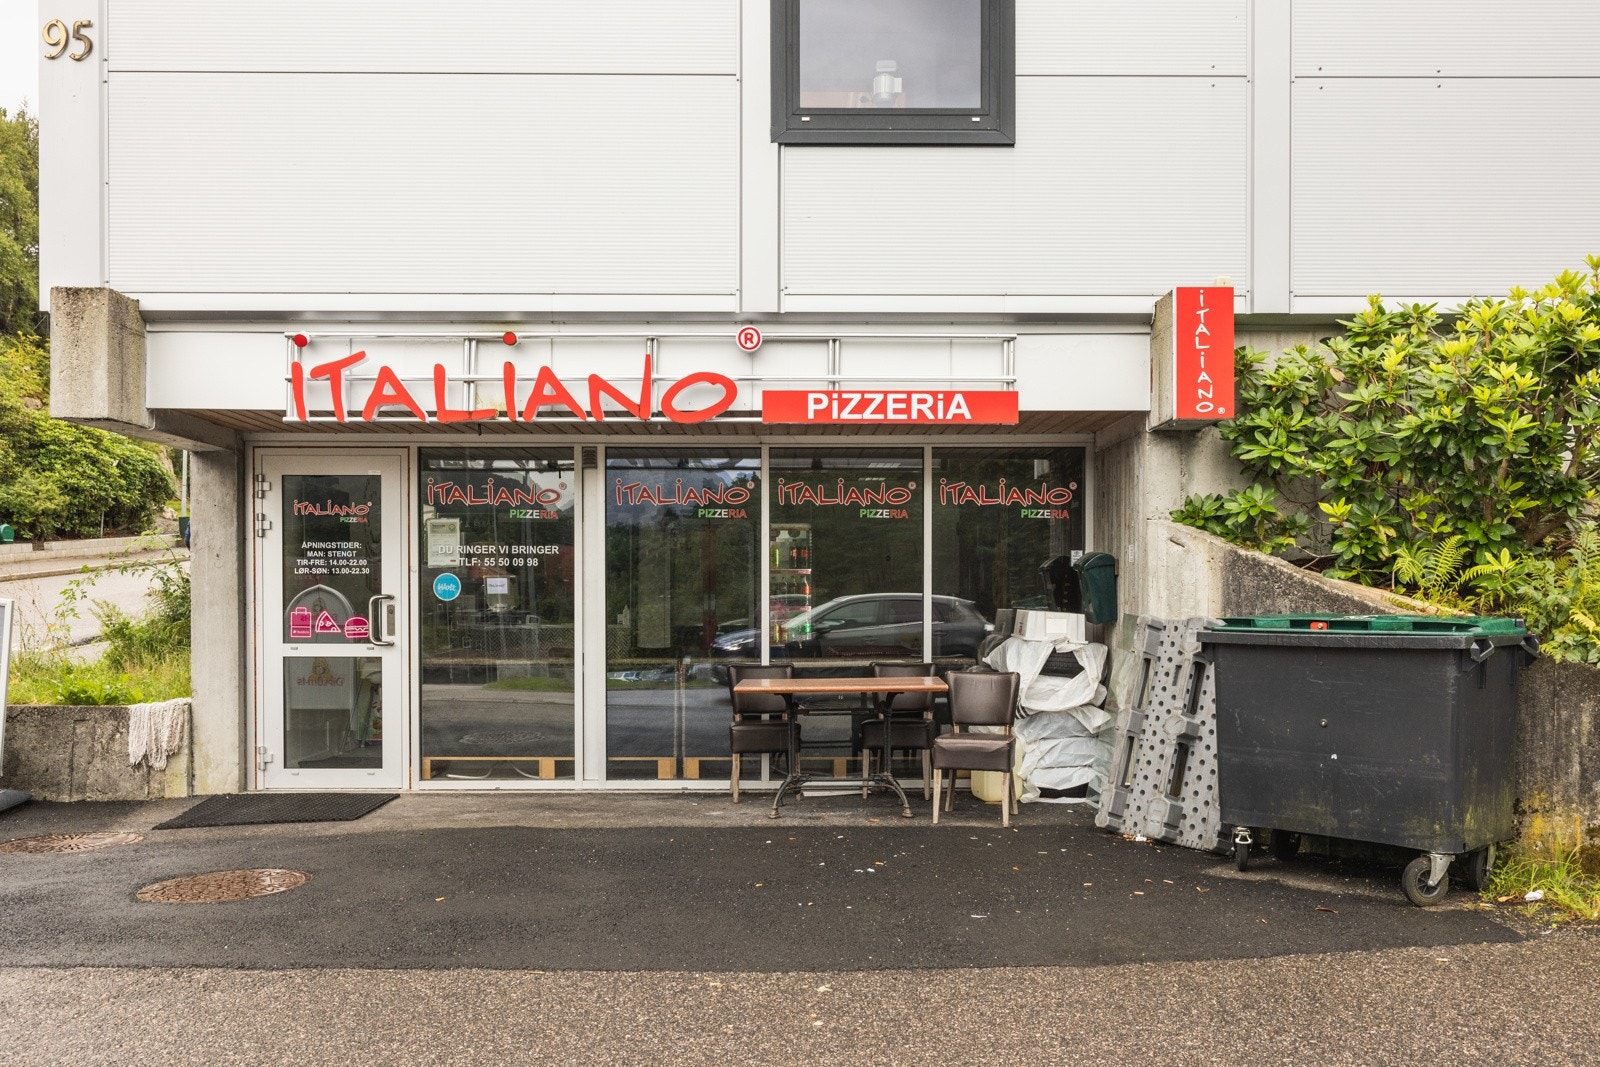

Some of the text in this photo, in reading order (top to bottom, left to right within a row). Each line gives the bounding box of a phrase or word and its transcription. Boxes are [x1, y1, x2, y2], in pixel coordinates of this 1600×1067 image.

[42, 19, 93, 61] 95
[509, 509, 559, 519] PIZZERIA
[698, 508, 747, 518] PIZZERIA
[859, 508, 908, 518] PIZZERIA
[1021, 508, 1069, 519] PIZZERIA
[301, 541, 362, 549] ÅPNINGSTIDER:
[438, 545, 559, 554] DU RINGER VI BRINGER
[459, 558, 481, 566] TLF:
[484, 558, 495, 566] 55
[498, 558, 510, 566] 50
[512, 558, 524, 566] 09
[527, 558, 539, 566] 98
[437, 582, 457, 593] Wolt
